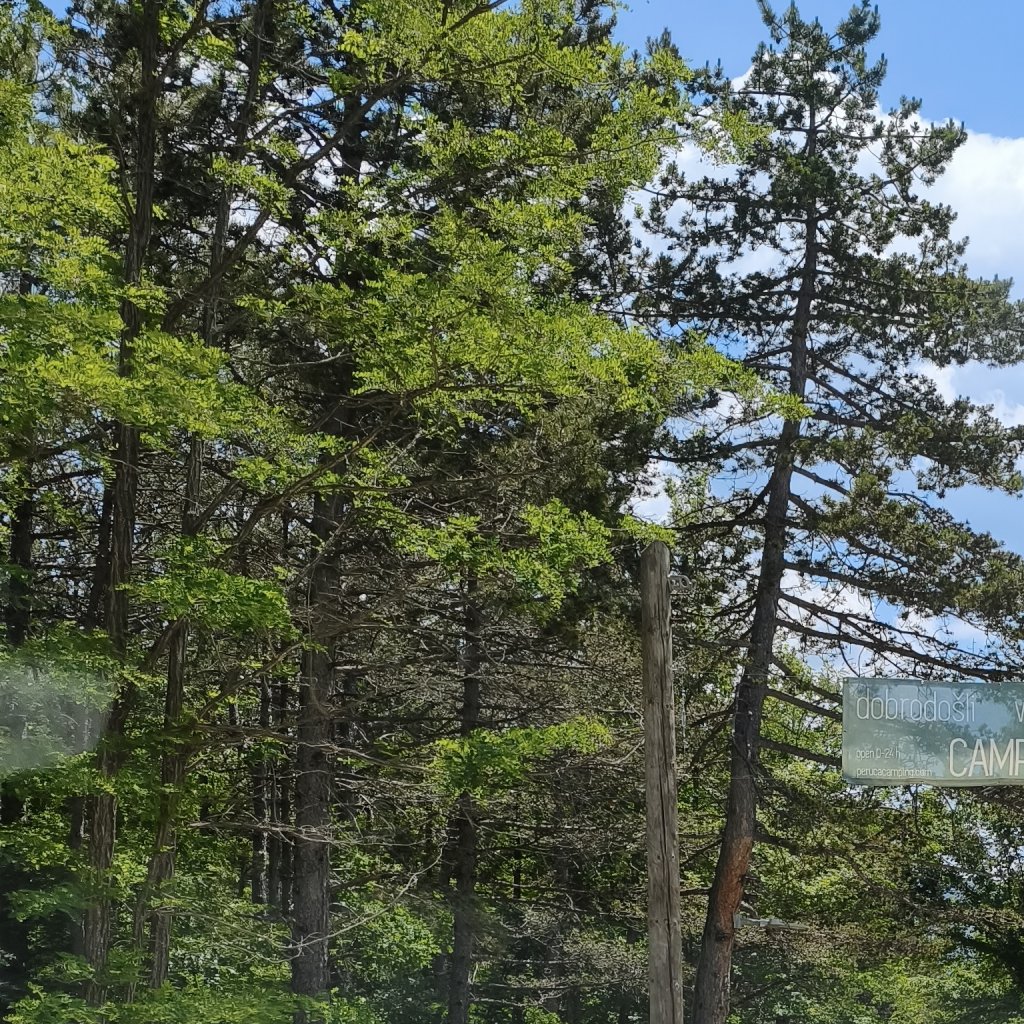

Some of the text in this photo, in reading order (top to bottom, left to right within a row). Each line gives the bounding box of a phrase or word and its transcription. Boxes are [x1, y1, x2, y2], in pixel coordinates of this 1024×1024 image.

[856, 688, 975, 722] dobrodošli
[856, 749, 875, 761] open
[856, 767, 932, 778] perucacamping.com
